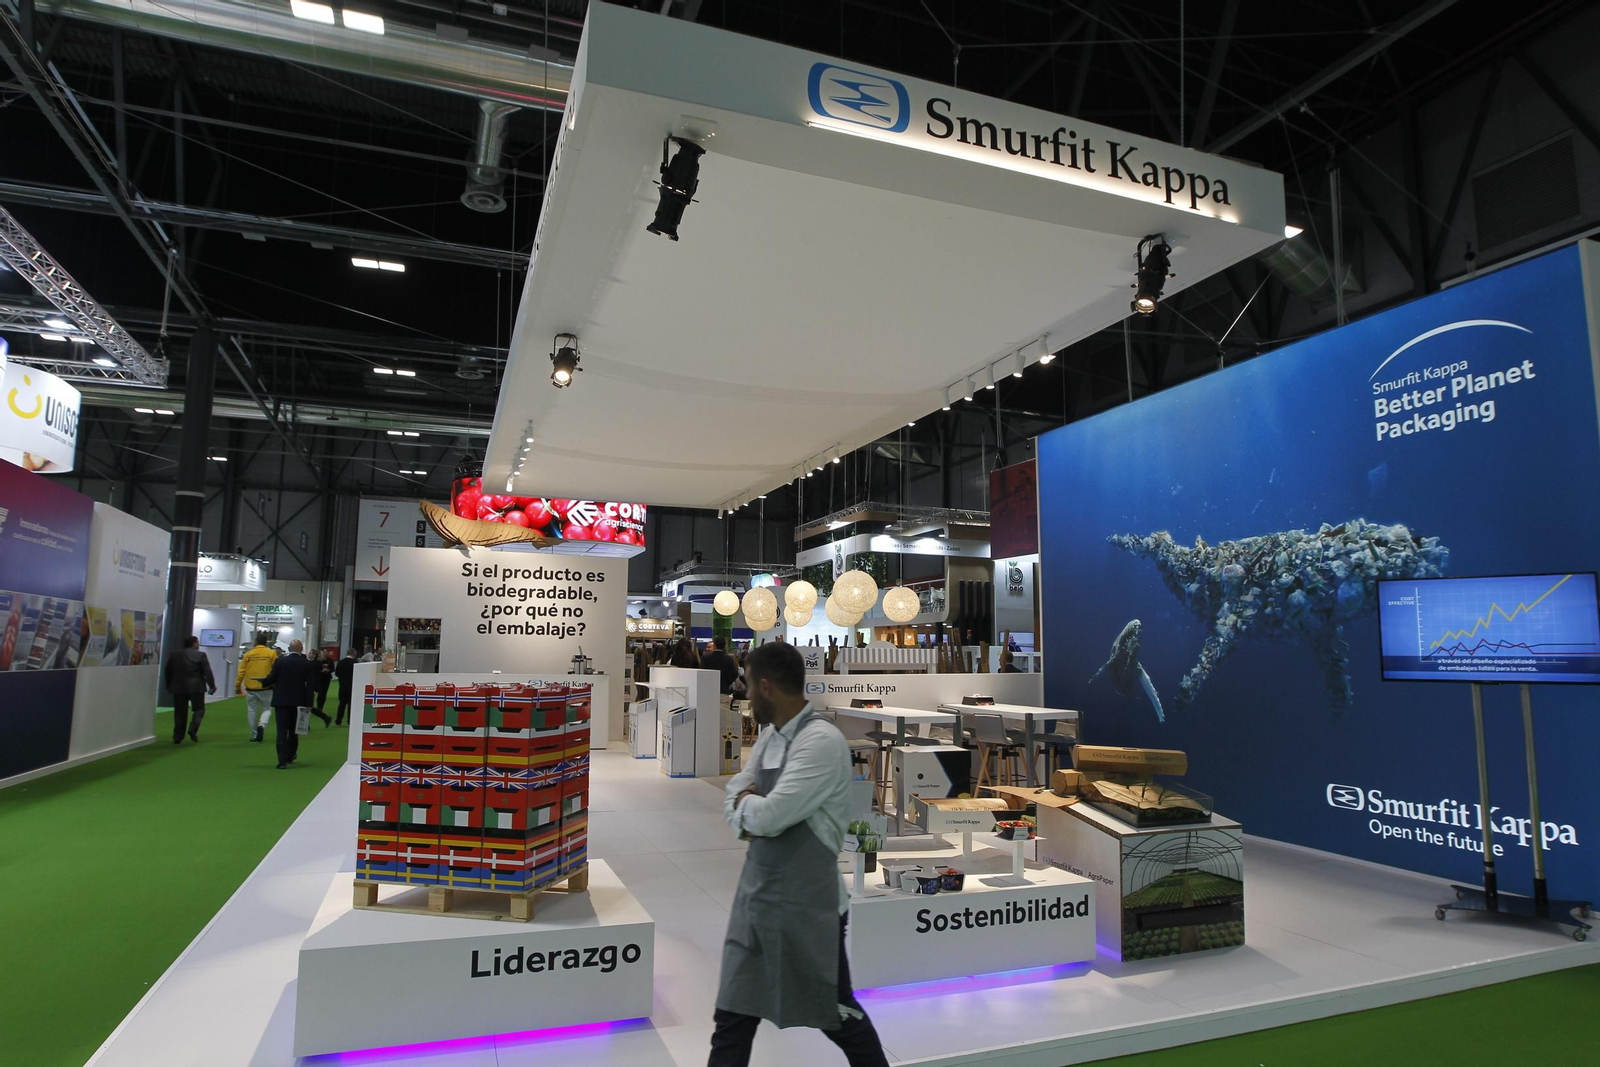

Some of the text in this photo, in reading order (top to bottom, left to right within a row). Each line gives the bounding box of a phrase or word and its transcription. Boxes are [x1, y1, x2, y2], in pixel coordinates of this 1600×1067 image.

[925, 97, 1232, 211] Smurfit Kappa
[1372, 359, 1469, 395] Smurfit Kappa
[1374, 358, 1537, 418] Better Planet
[1376, 400, 1496, 442] Packaging
[379, 511, 390, 528] 7
[461, 562, 605, 583] Si el producto es
[467, 582, 598, 603] biodegradable,
[480, 603, 584, 620] ¿por qué no
[476, 620, 586, 640] el embalaje?
[638, 623, 670, 631] CORTEVA
[1447, 665, 1478, 673] embalajes
[828, 683, 897, 695] Smurfit Kappa
[1367, 789, 1580, 850] Smurfit Kappa
[1368, 818, 1504, 857] Open the futue
[1087, 871, 1114, 886] AgroPaper
[915, 893, 1089, 934] Sostenibilidad
[470, 942, 642, 979] Liderazgo
